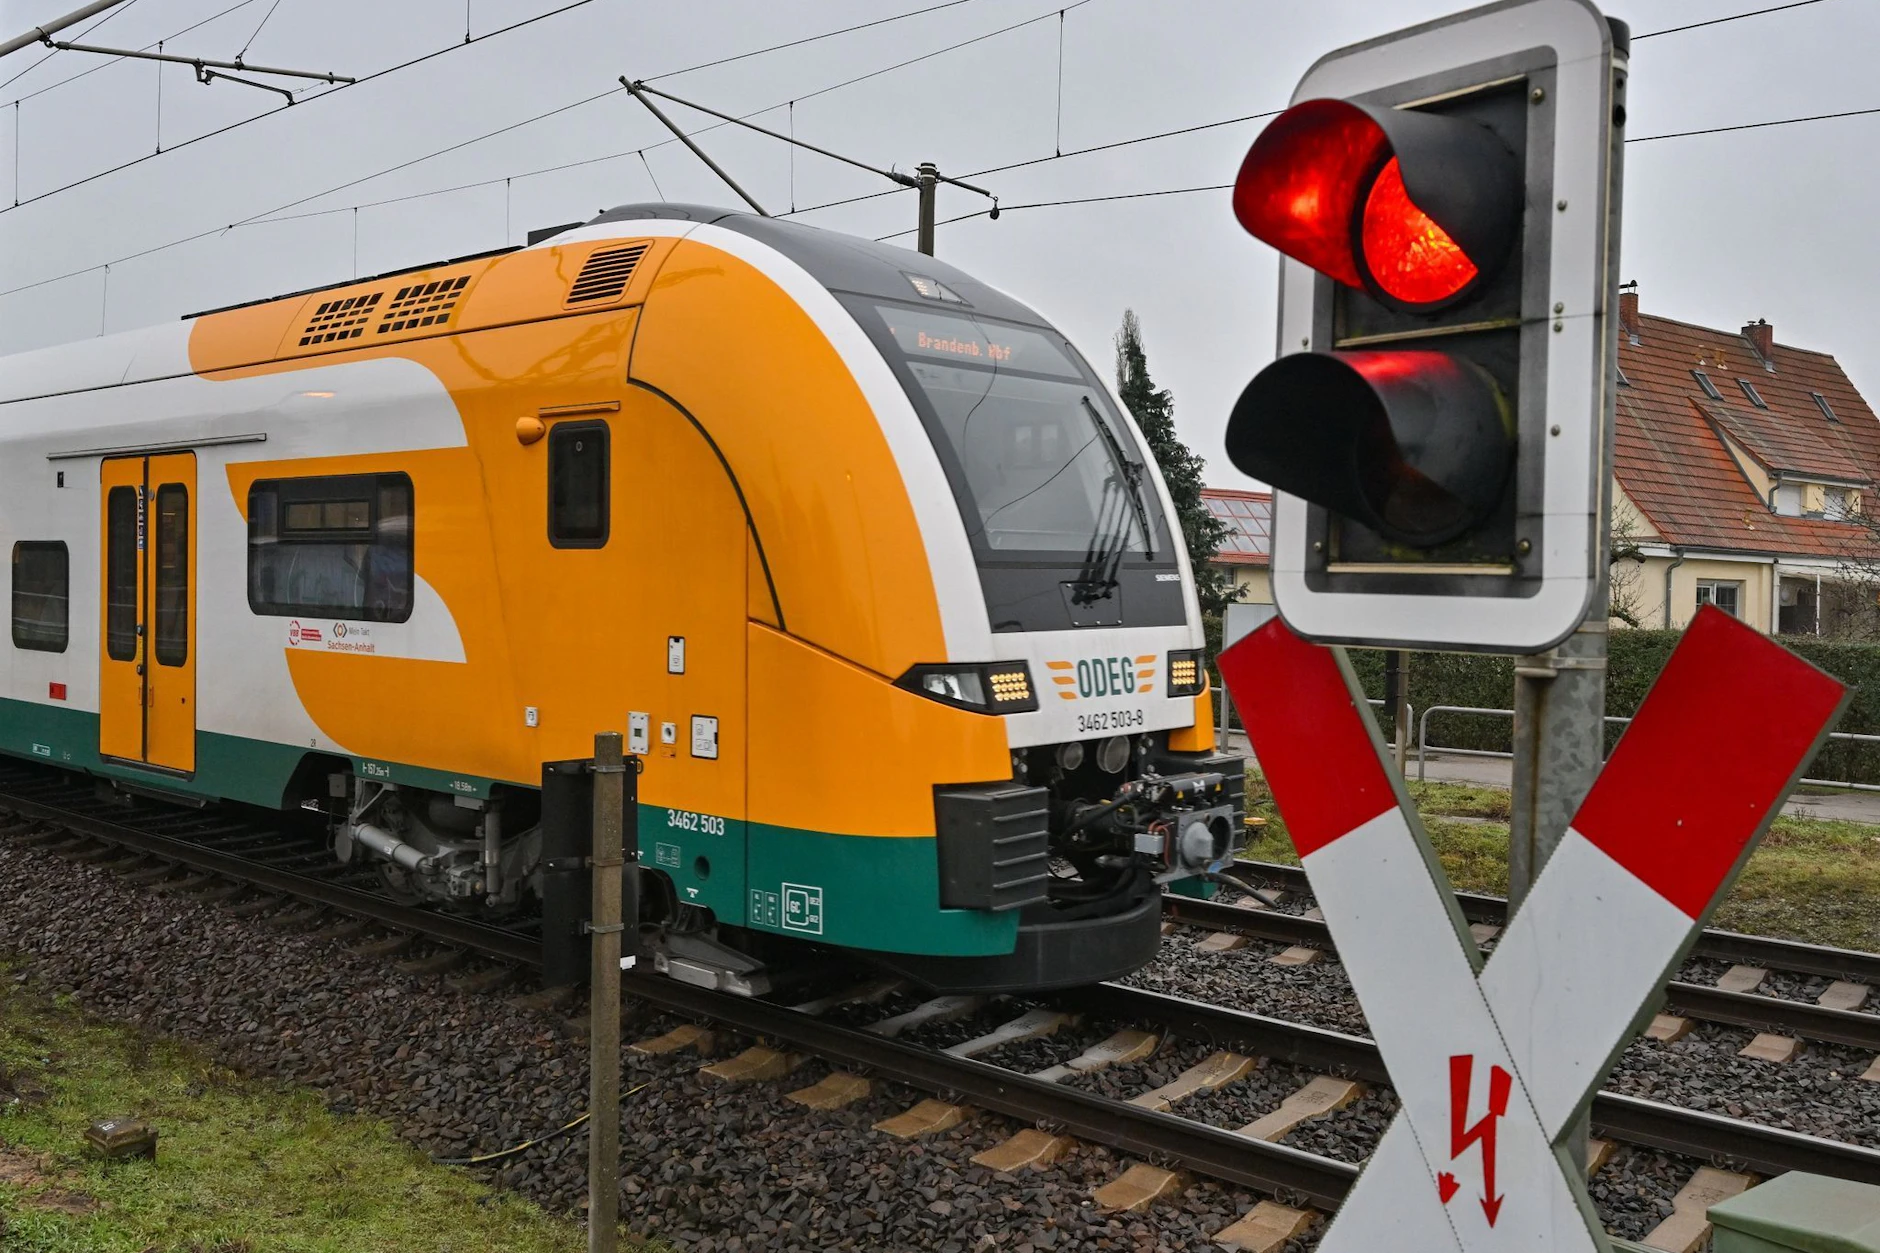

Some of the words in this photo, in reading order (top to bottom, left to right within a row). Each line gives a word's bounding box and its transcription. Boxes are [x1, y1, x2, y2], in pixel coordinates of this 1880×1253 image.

[918, 331, 983, 357] Brandenb.
[987, 343, 1012, 361] Hbf
[327, 640, 375, 653] Sachsen-Anhalt
[1077, 656, 1135, 699] ODEG
[1077, 713, 1108, 733] 3462
[1110, 709, 1144, 729] 503-8
[667, 808, 698, 832] 3462
[700, 814, 725, 836] 503
